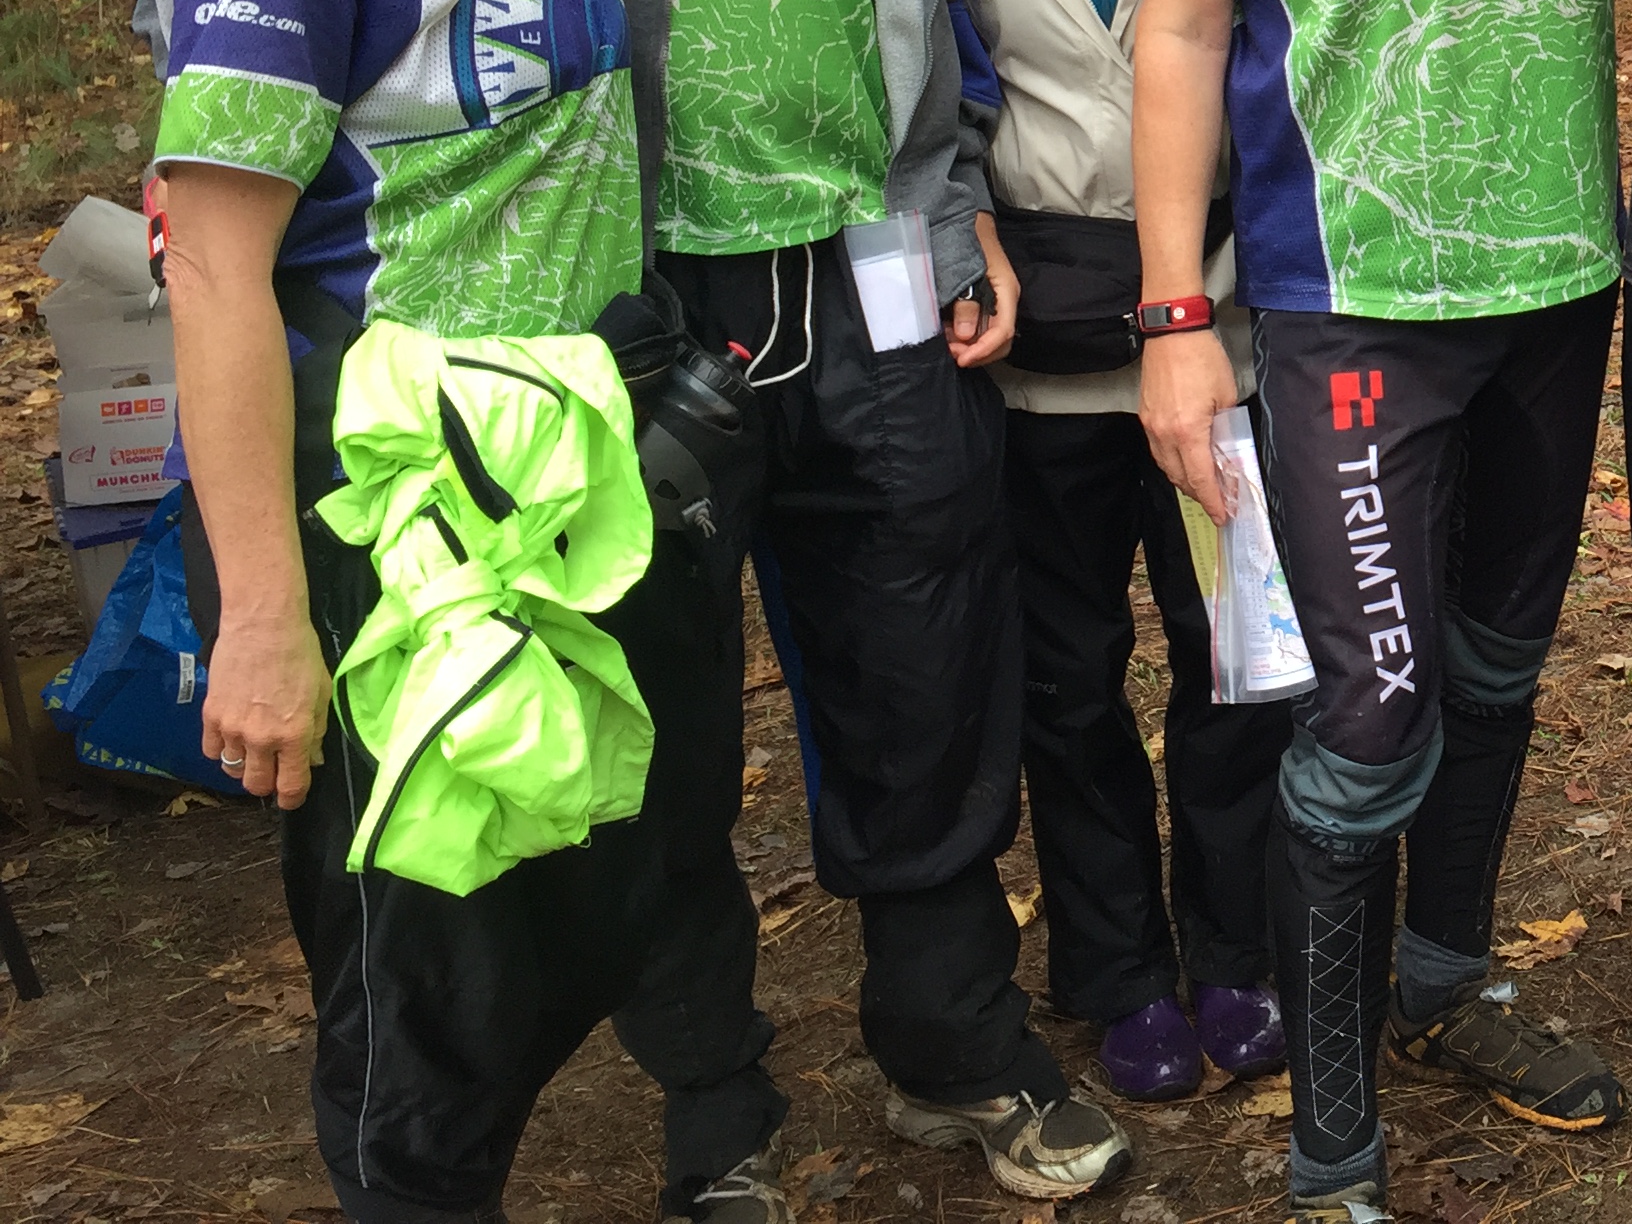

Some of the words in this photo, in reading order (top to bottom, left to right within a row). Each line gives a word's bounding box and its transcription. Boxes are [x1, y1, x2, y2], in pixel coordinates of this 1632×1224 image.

[520, 29, 542, 46] E
[125, 454, 165, 465] DONUTS
[1337, 444, 1416, 704] TRIMTEX
